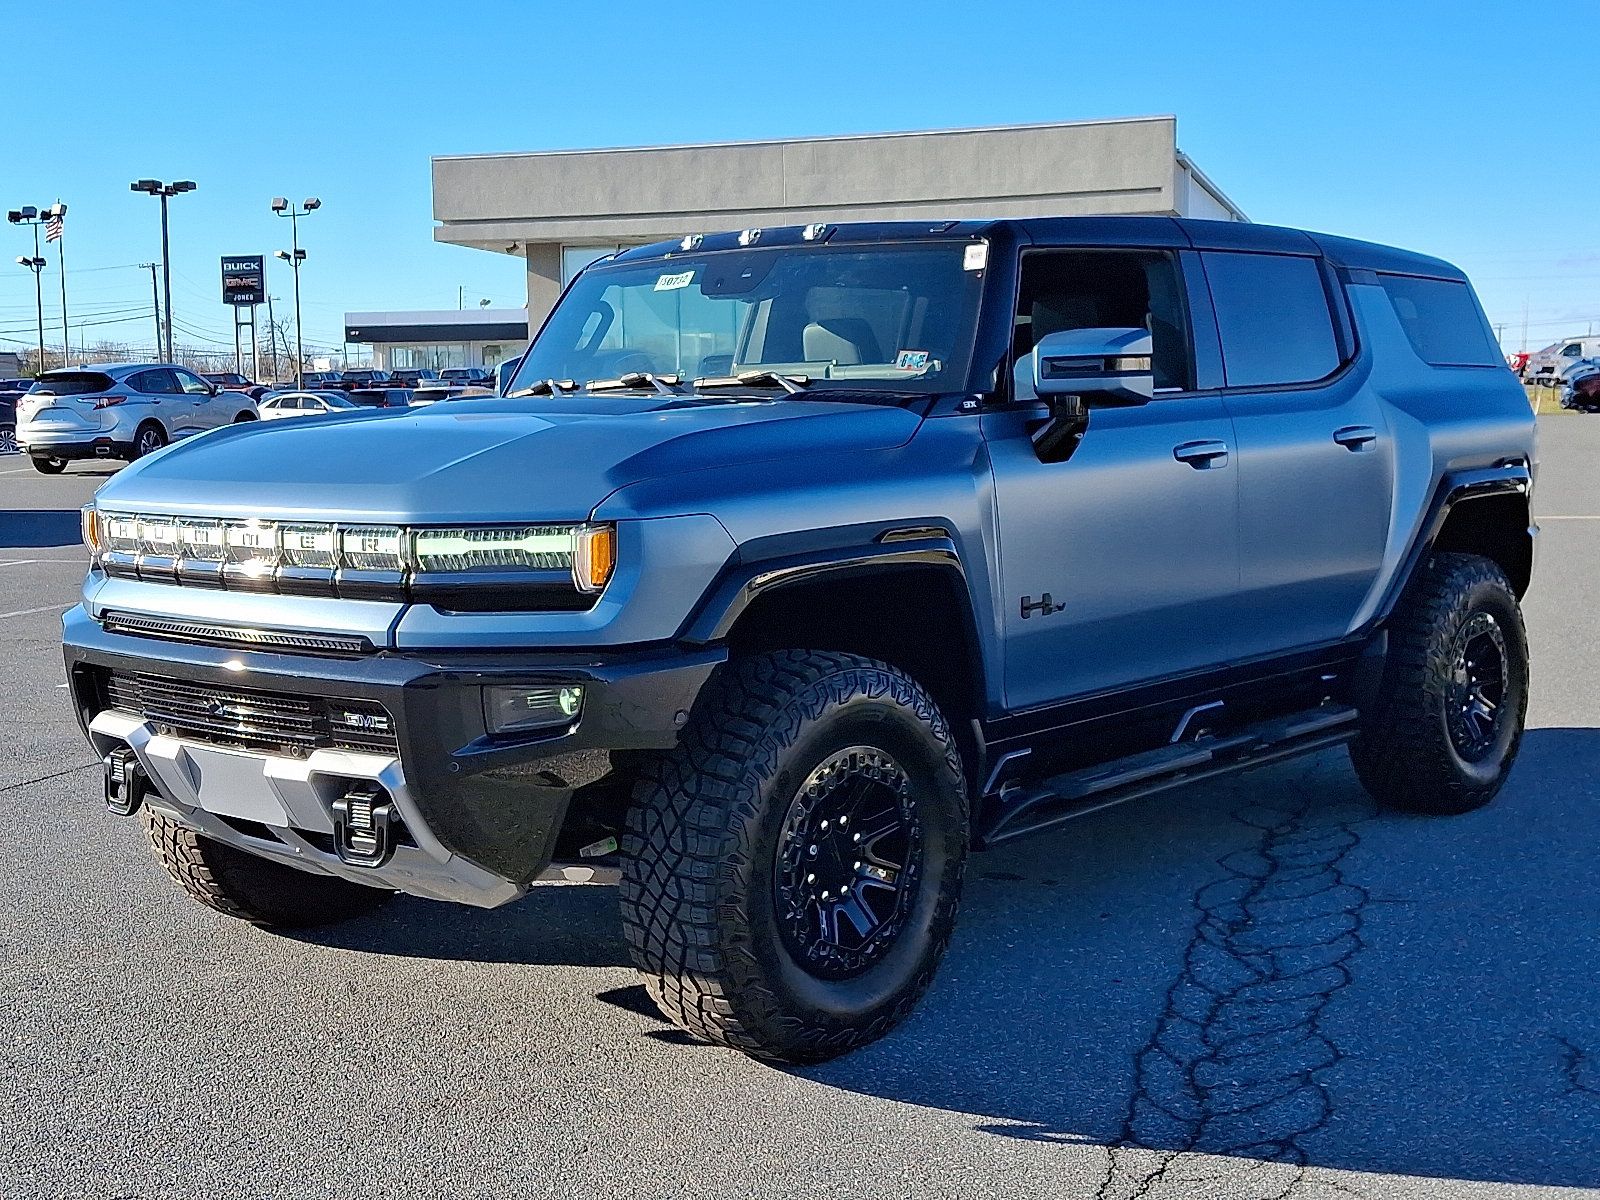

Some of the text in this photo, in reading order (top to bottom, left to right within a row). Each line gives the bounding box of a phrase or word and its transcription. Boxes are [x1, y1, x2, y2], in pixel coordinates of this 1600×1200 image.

[223, 262, 259, 271] BUICK
[225, 277, 259, 287] GMC
[343, 711, 389, 729] GMC
